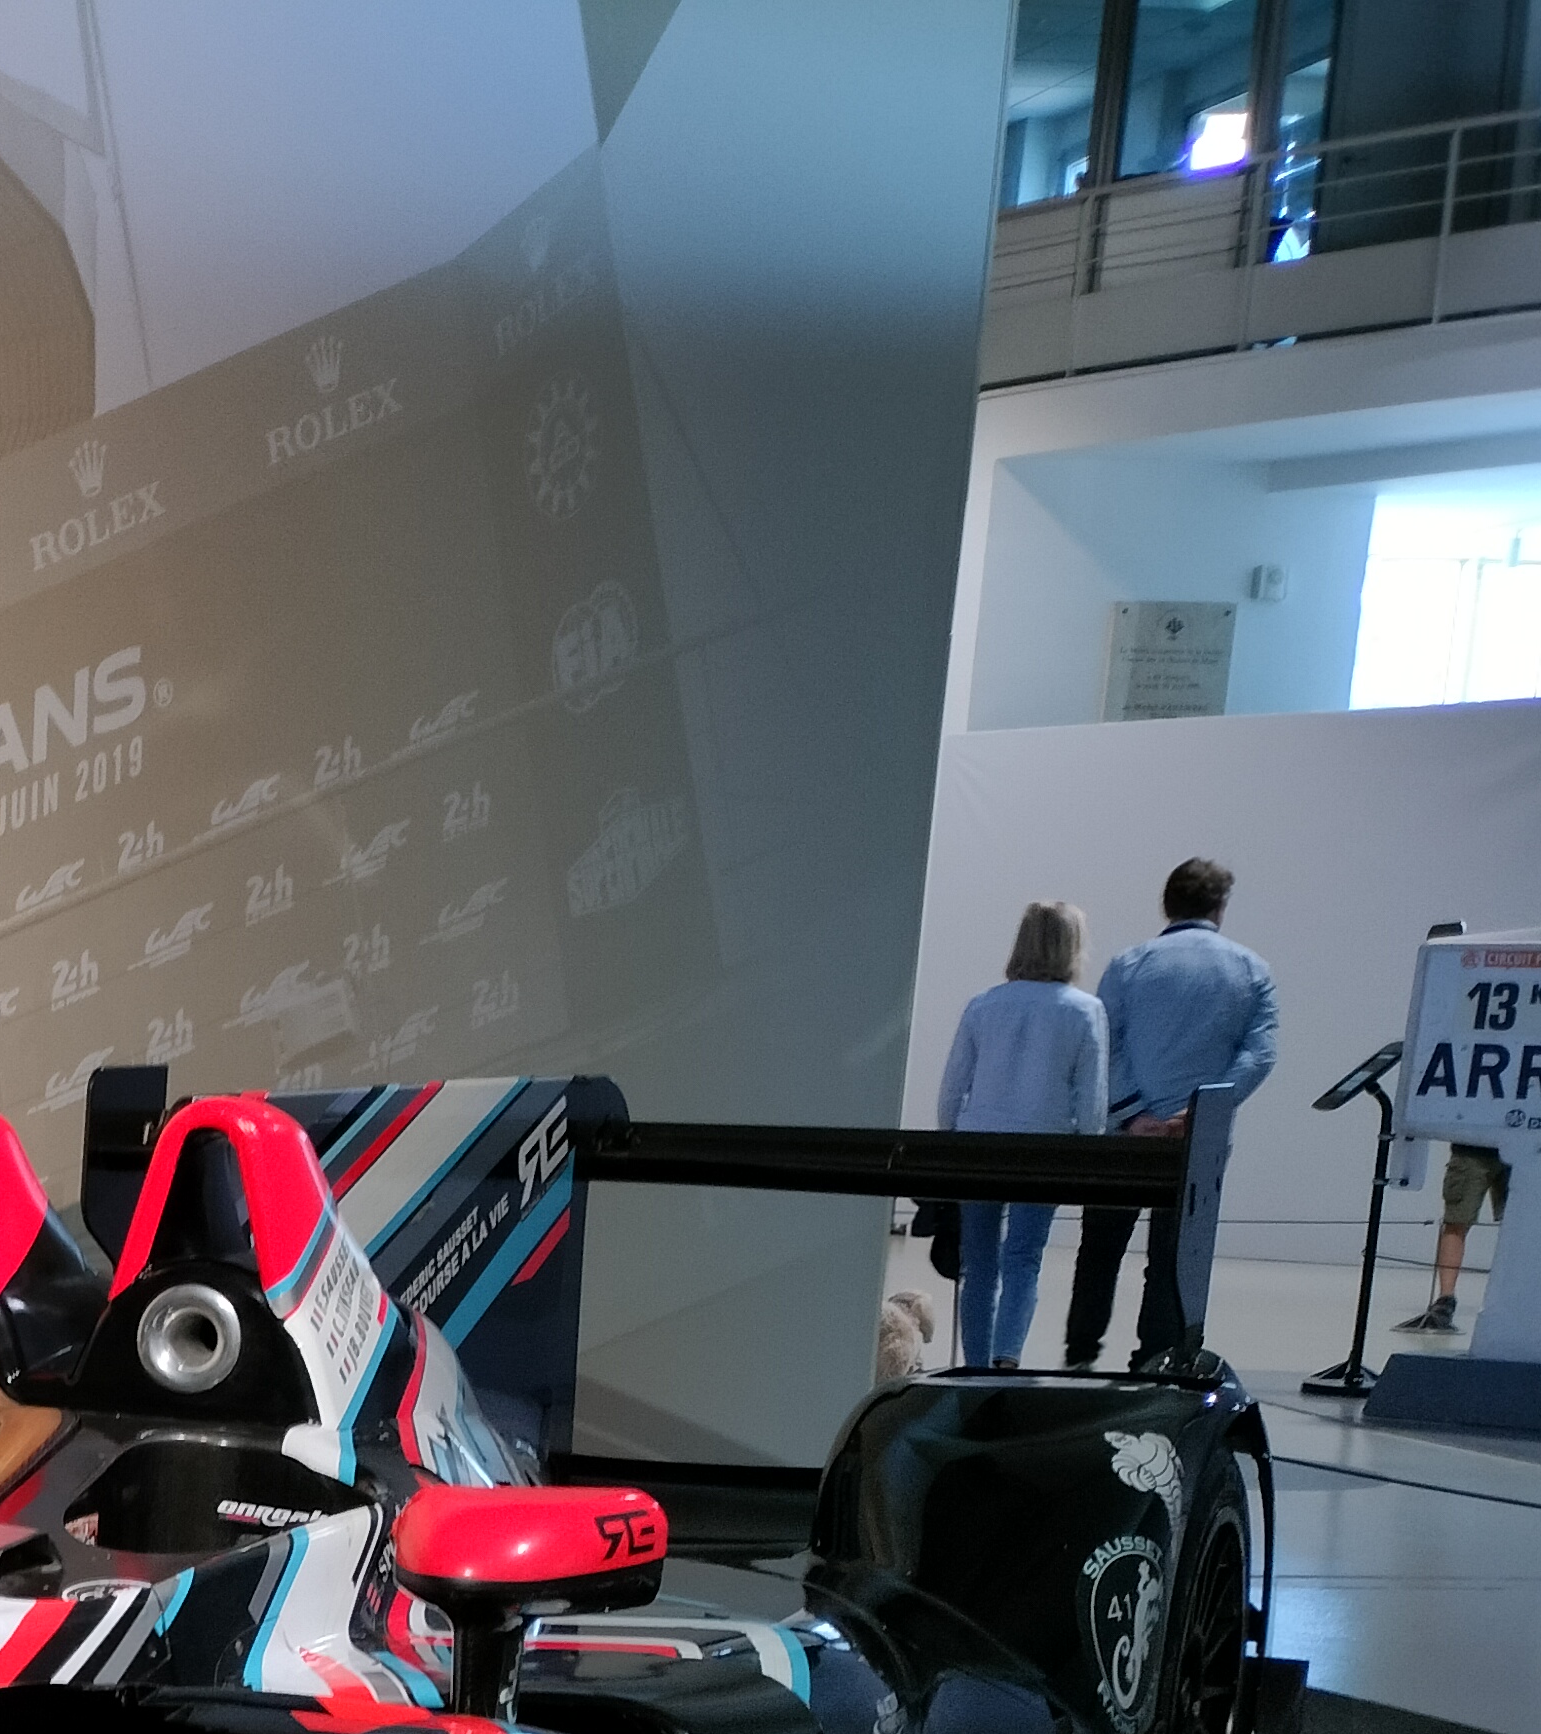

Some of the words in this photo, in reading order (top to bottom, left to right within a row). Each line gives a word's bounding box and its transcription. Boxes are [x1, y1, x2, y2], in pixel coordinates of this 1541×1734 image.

[264, 378, 403, 469] ROLEX
[29, 481, 167, 571] ROLEX
[75, 735, 145, 806] 2019
[1468, 982, 1520, 1031] 13
[437, 1205, 479, 1268] SAUSSET
[472, 1220, 488, 1252] LA
[489, 1192, 510, 1229] VIE
[1107, 1593, 1132, 1622] 41
